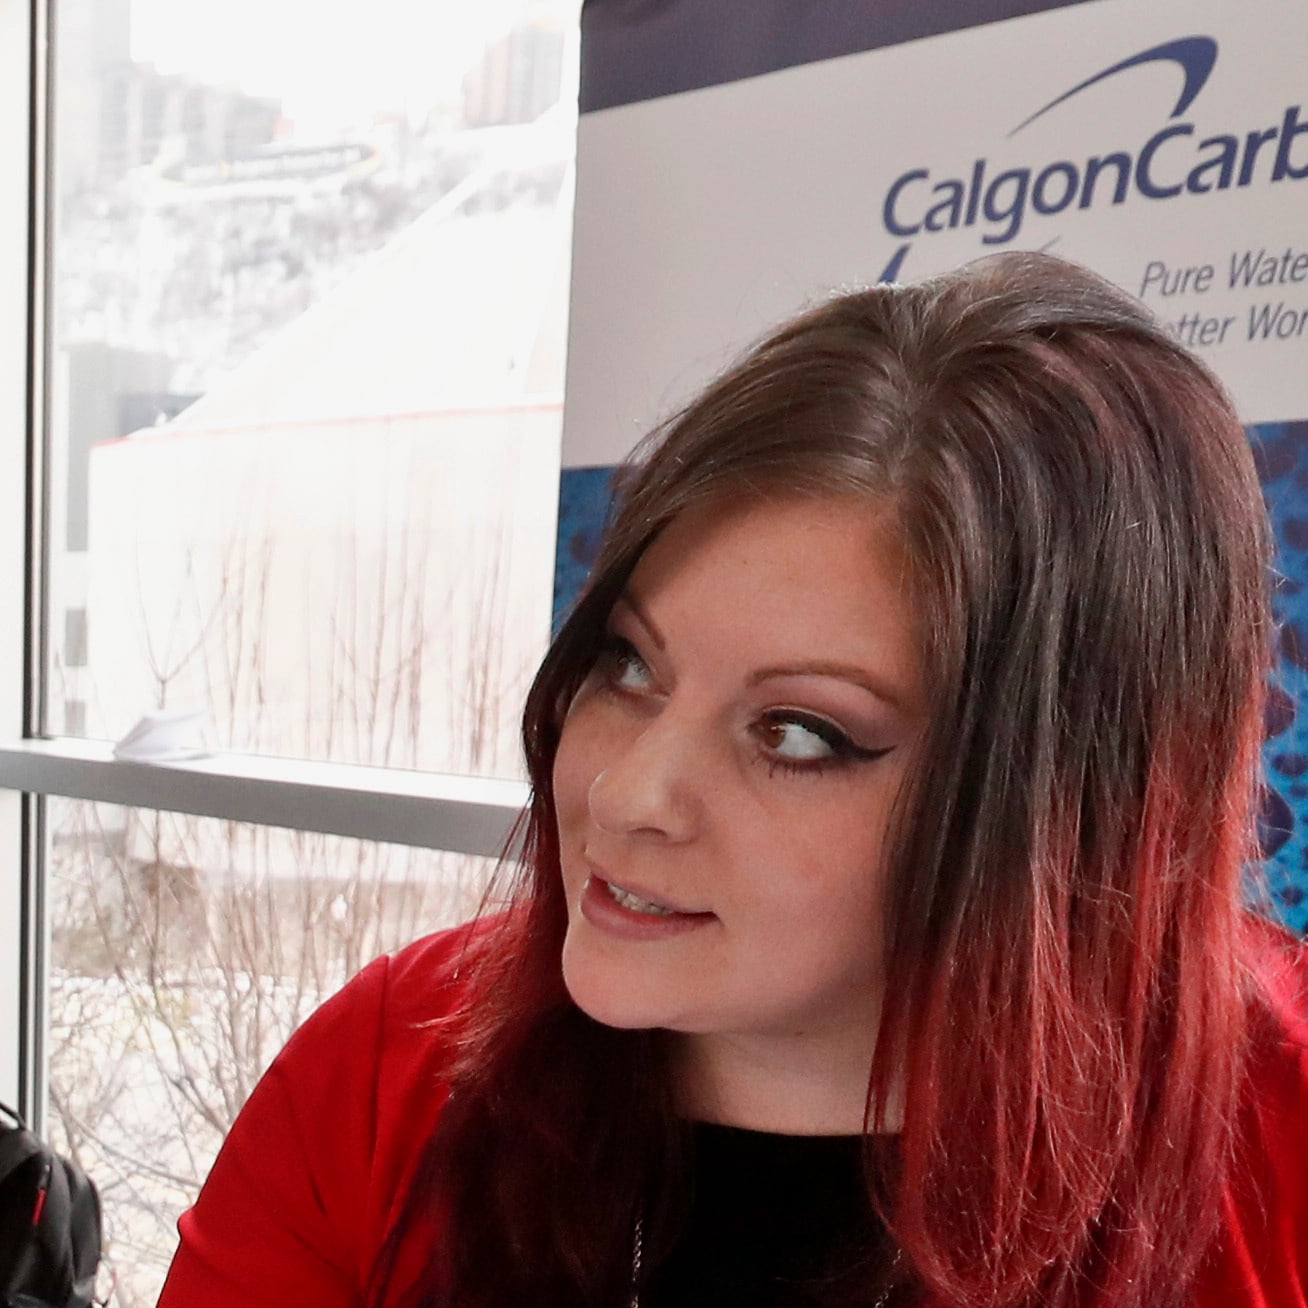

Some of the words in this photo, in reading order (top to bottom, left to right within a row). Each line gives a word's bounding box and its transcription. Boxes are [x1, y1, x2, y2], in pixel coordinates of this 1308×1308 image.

[883, 105, 1308, 246] CalgonCarb
[1139, 260, 1215, 298] Pure
[1229, 248, 1308, 289] Wate
[1161, 312, 1237, 348] tter
